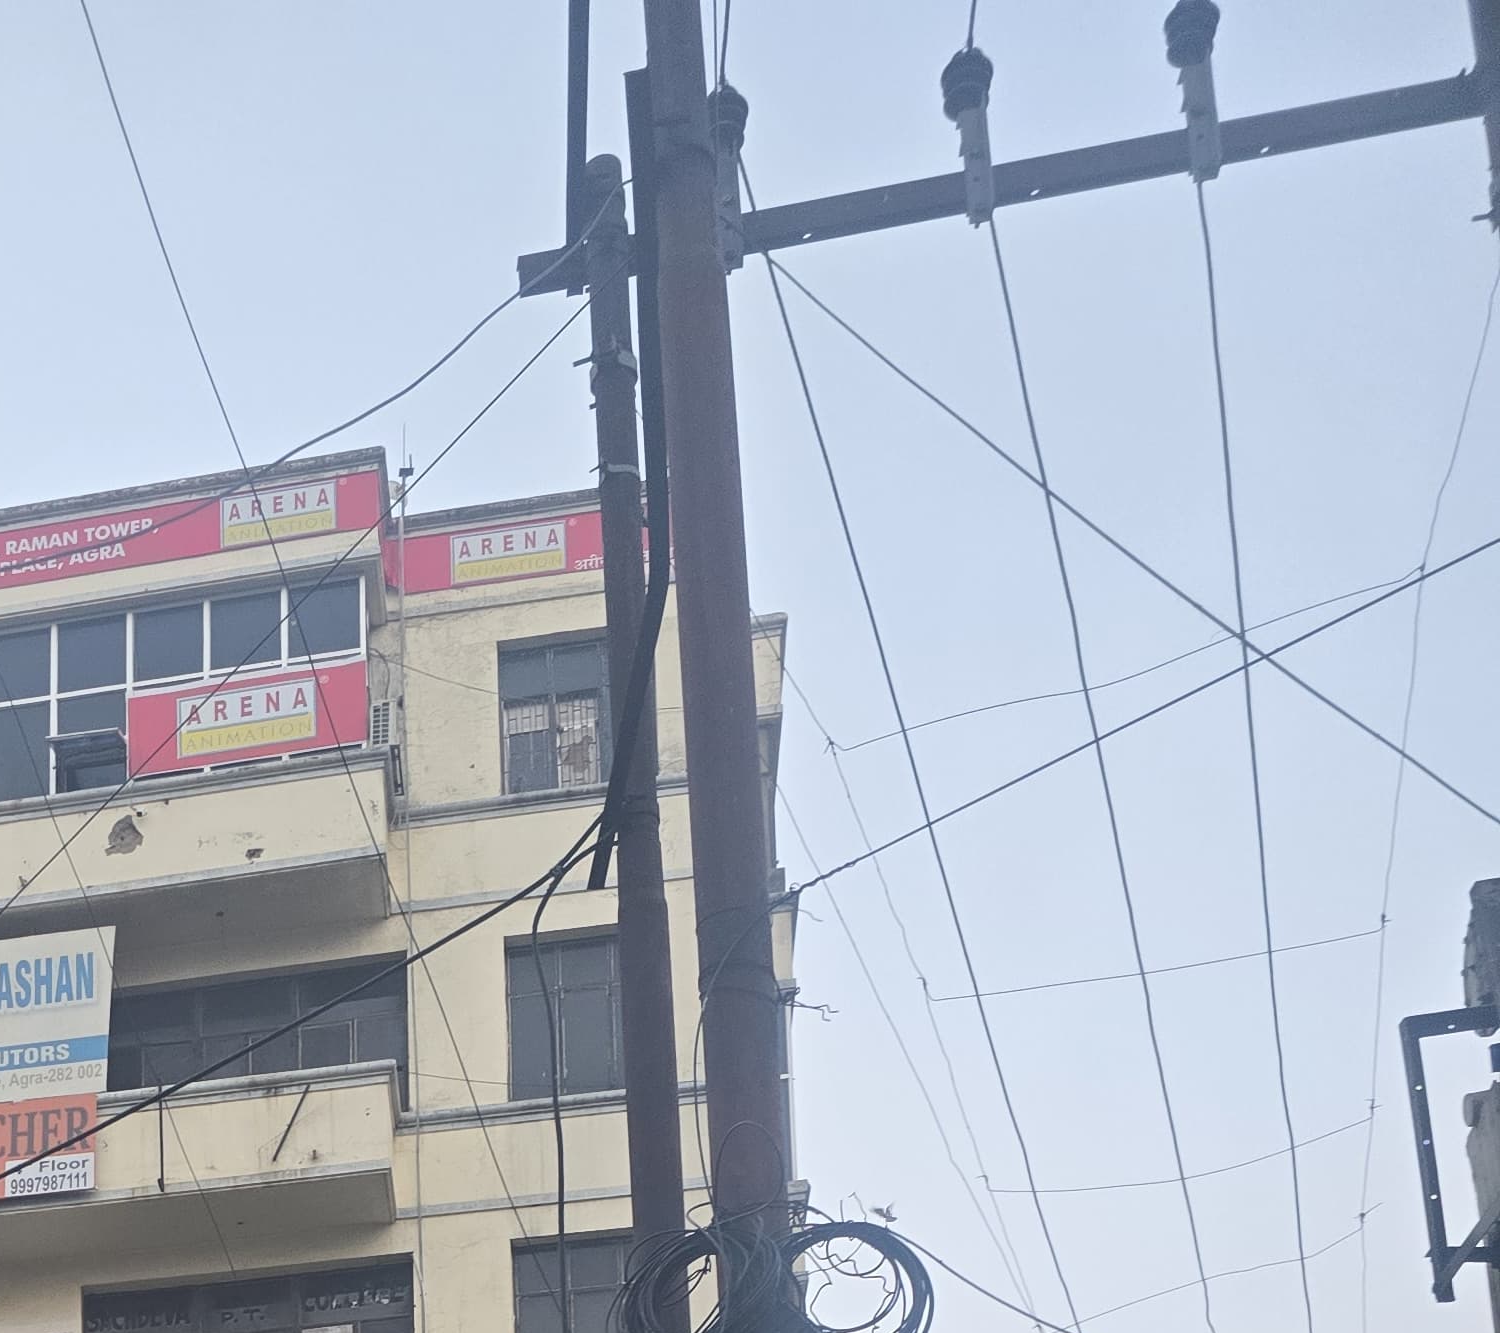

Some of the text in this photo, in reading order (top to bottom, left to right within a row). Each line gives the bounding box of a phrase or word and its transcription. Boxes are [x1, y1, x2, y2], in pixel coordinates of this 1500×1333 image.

[229, 488, 329, 521] ARENA
[6, 533, 78, 556] RAMAN
[85, 518, 159, 542] TOWER,
[459, 529, 559, 558] ARENA
[69, 543, 126, 564] AGRA
[186, 687, 308, 725] ARENA
[186, 718, 312, 750] ANIMATION
[9, 1068, 73, 1090] Agra-282
[78, 1063, 103, 1080] 002
[39, 1157, 90, 1173] Floor
[10, 1171, 89, 1195] 9997987111
